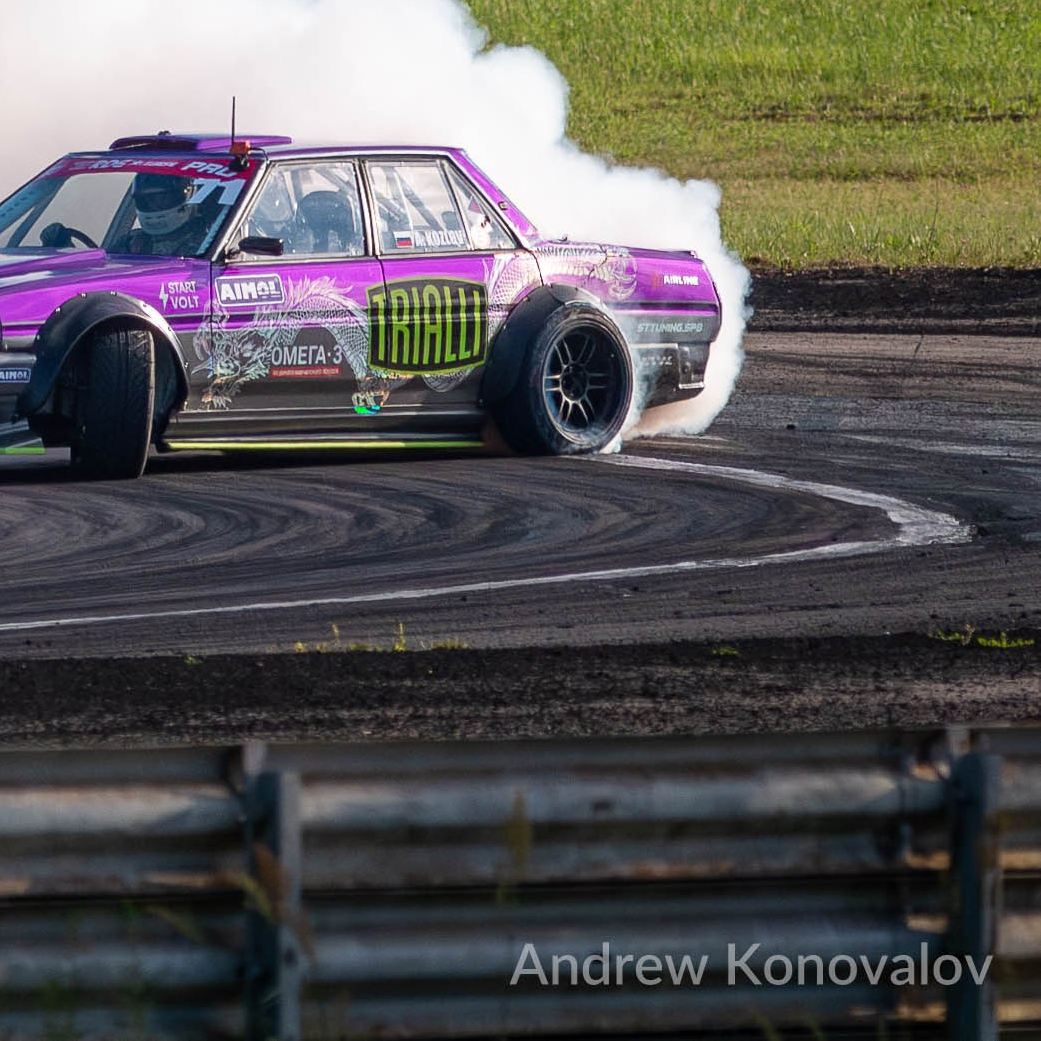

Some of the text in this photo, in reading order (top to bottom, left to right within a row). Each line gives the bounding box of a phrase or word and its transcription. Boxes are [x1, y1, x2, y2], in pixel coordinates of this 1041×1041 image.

[187, 178, 247, 205] 71
[167, 280, 197, 294] START
[663, 274, 699, 286] AIRLINE
[170, 295, 200, 309] VOLT
[372, 284, 481, 365] TRIALLI
